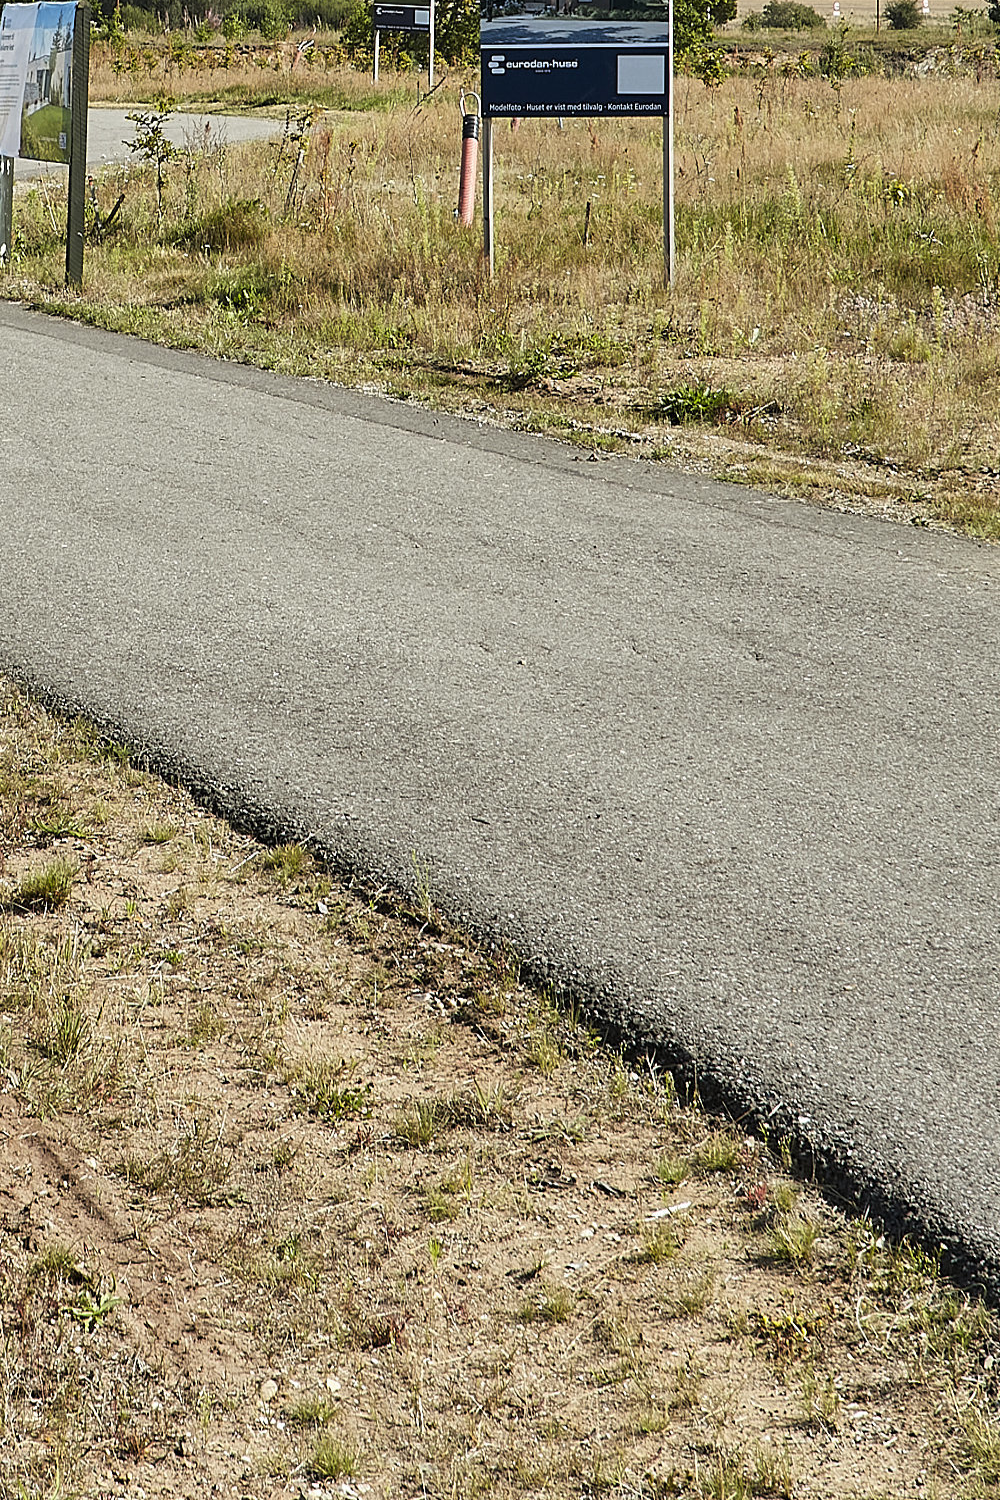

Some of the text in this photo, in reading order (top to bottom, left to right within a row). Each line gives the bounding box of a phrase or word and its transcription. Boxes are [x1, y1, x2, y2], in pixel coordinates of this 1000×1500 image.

[489, 103, 522, 111] Modelfoto
[526, 103, 545, 111] Huset
[554, 103, 566, 111] vist
[582, 102, 603, 112] tilvalg
[634, 102, 662, 110] Eurodan
